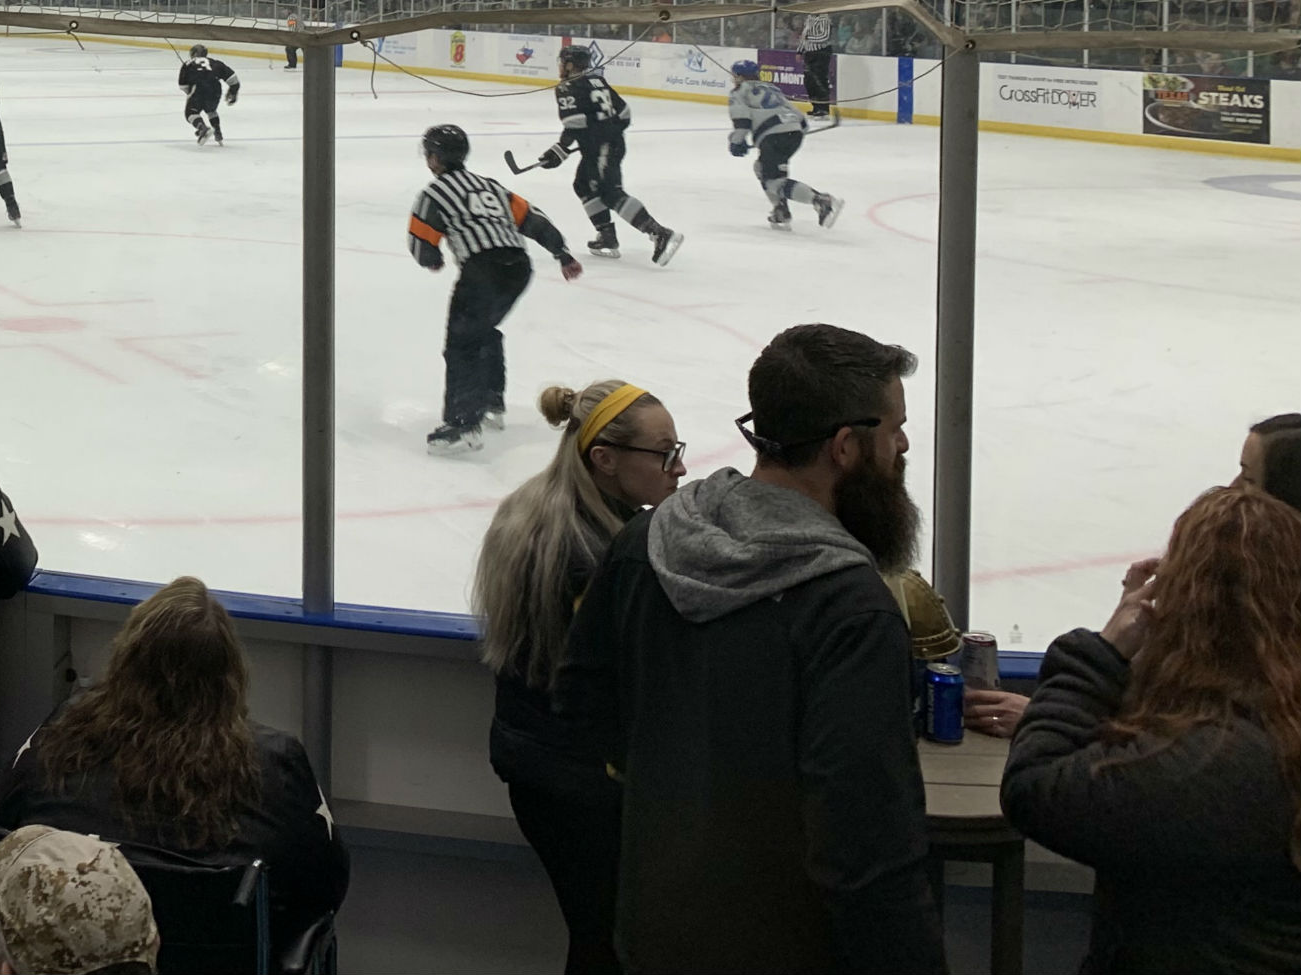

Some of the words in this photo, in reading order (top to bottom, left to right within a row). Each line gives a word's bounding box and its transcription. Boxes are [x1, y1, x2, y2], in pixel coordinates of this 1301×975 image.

[452, 43, 465, 62] 8
[666, 76, 683, 85] Alpha
[684, 77, 700, 85] Care
[701, 78, 726, 88] Medical
[773, 72, 781, 83] A
[781, 72, 805, 86] MONT
[558, 95, 578, 111] 32
[999, 84, 1050, 105] CrossFit
[1197, 91, 1265, 109] STEAKS
[467, 190, 506, 220] 49
